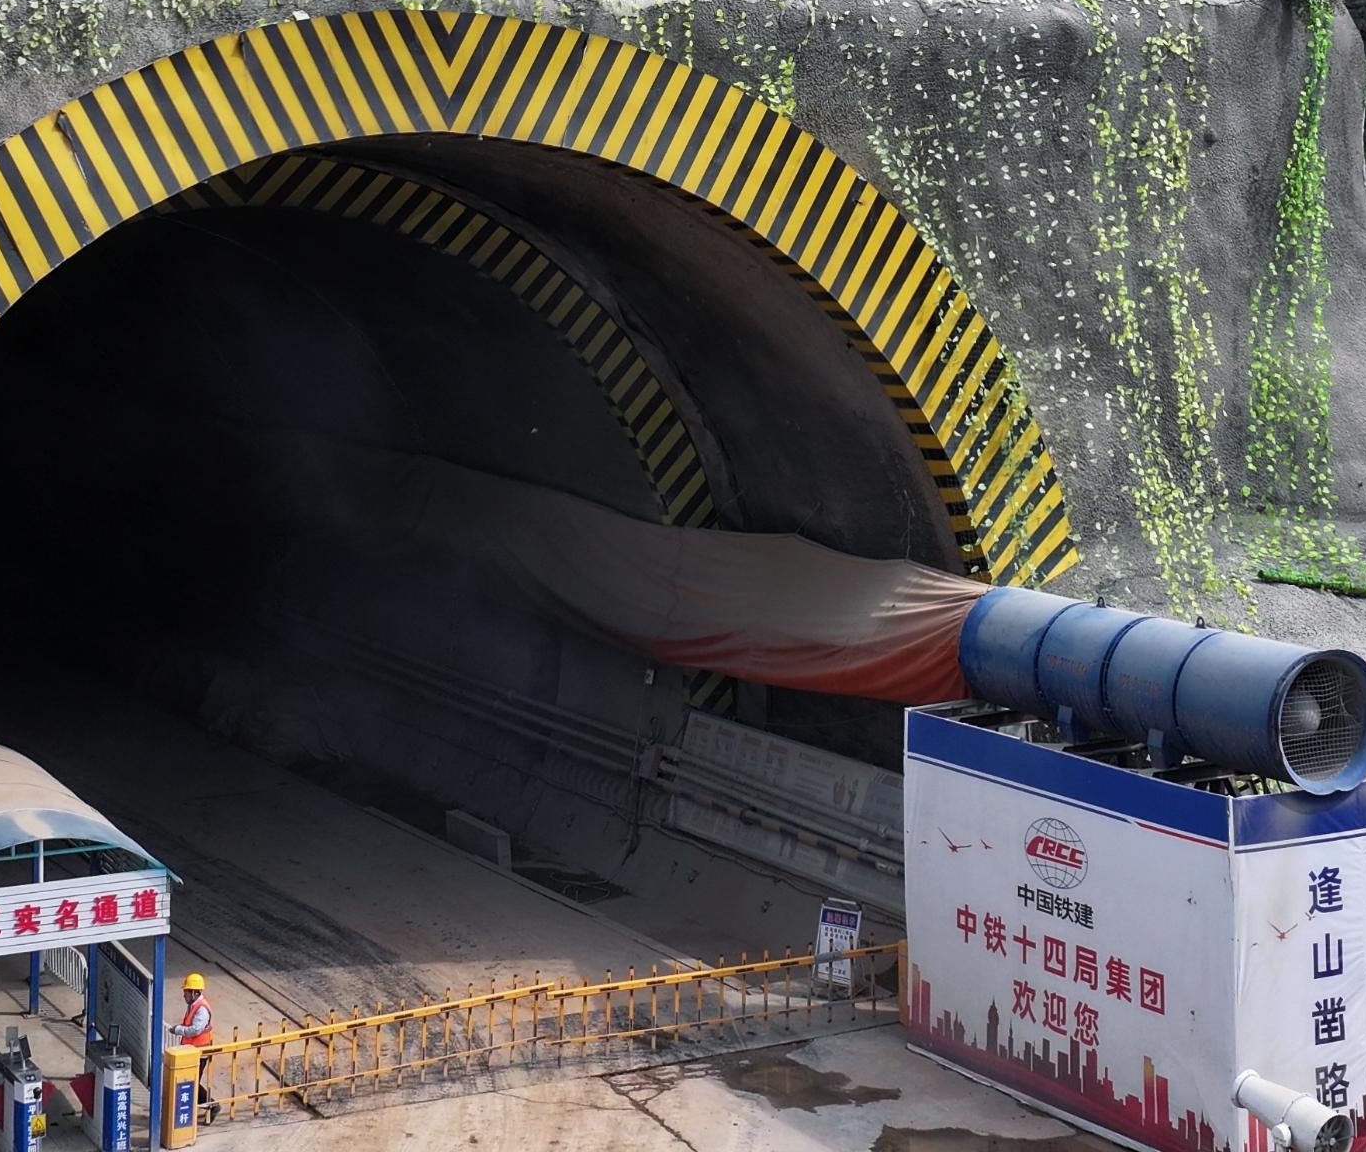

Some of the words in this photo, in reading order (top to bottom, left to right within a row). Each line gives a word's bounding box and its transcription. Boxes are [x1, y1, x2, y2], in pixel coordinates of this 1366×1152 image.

[1026, 835, 1085, 870] CRCC
[1017, 883, 1094, 930] 中国铁建
[956, 904, 1165, 1016] 中铁十四局集团
[1308, 866, 1350, 1109] 逢山凿路
[1012, 979, 1099, 1046] 欢迎您
[116, 1091, 128, 1151] 高高兴兴上班
[179, 1084, 191, 1125] 一车一杆
